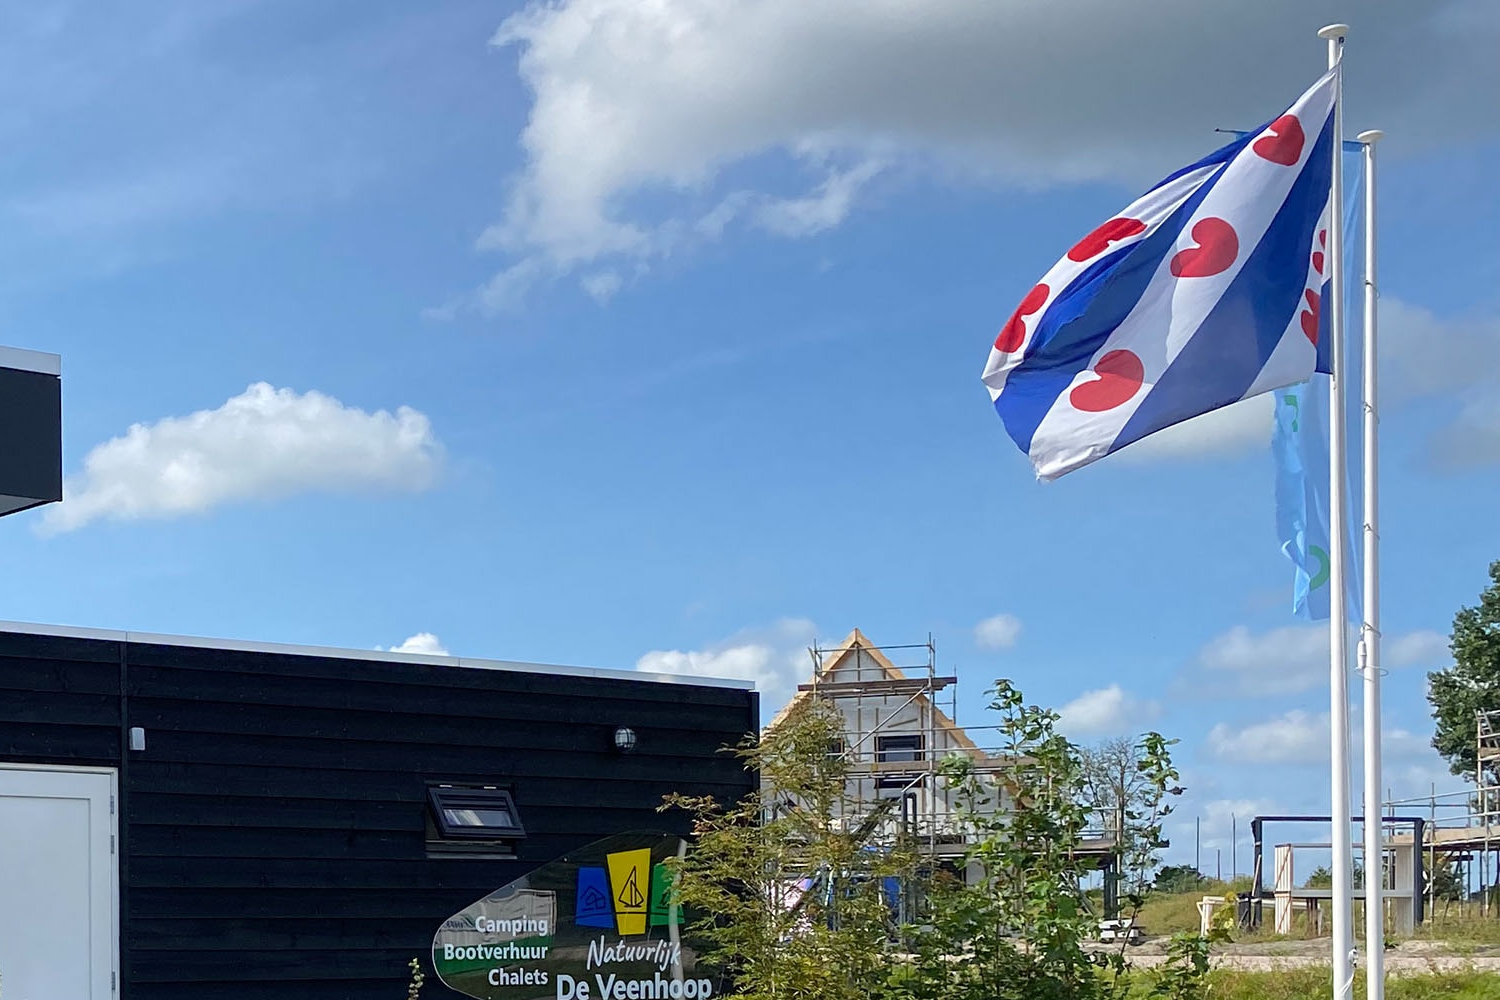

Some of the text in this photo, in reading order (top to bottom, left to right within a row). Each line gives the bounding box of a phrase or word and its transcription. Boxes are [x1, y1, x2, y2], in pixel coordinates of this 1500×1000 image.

[475, 914, 548, 937] Camping
[444, 941, 548, 960] Bootverhuur
[586, 934, 681, 972] Natuurlijk
[488, 968, 548, 986] Chalets
